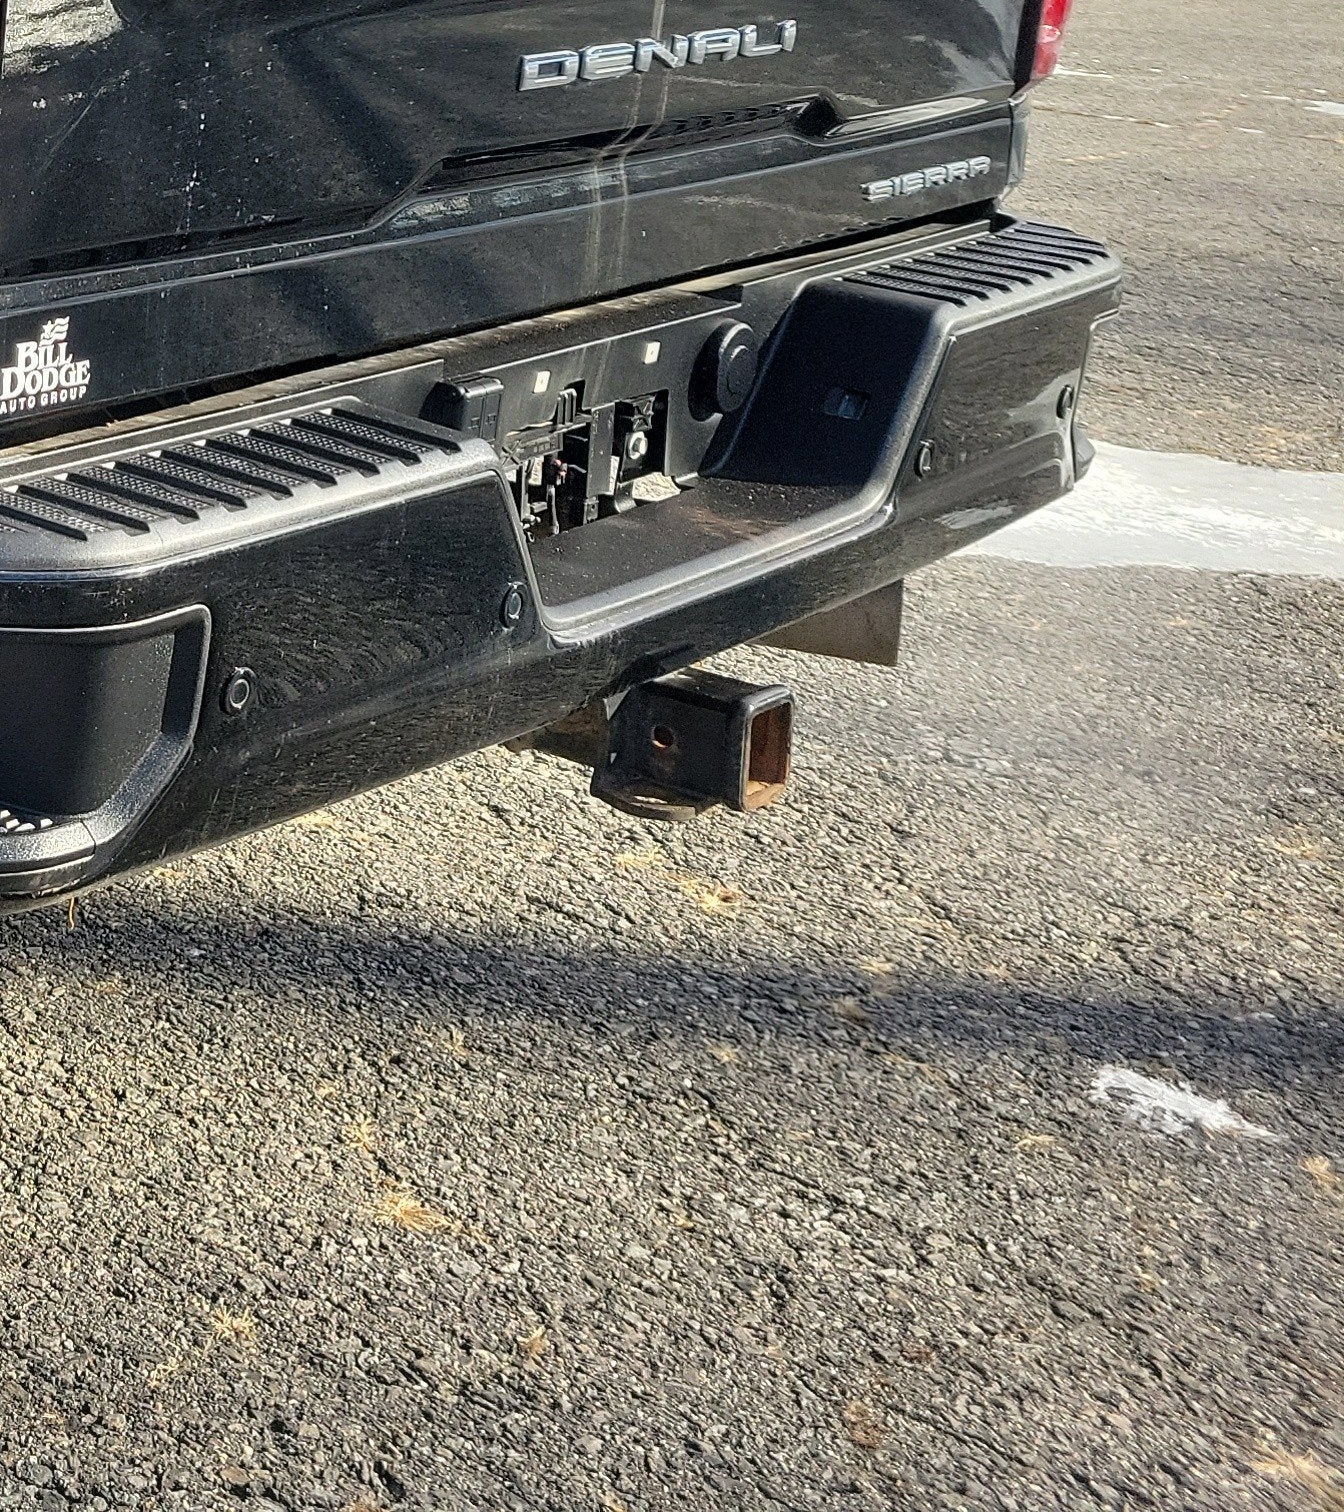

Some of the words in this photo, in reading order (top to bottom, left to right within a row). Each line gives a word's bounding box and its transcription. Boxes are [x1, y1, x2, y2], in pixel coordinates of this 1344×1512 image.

[518, 19, 798, 92] DENALI
[861, 155, 992, 203] SIERRA
[16, 341, 73, 372] BILL
[0, 359, 91, 401] DODGE
[0, 396, 36, 415] AUTO
[40, 385, 87, 406] GROUP
